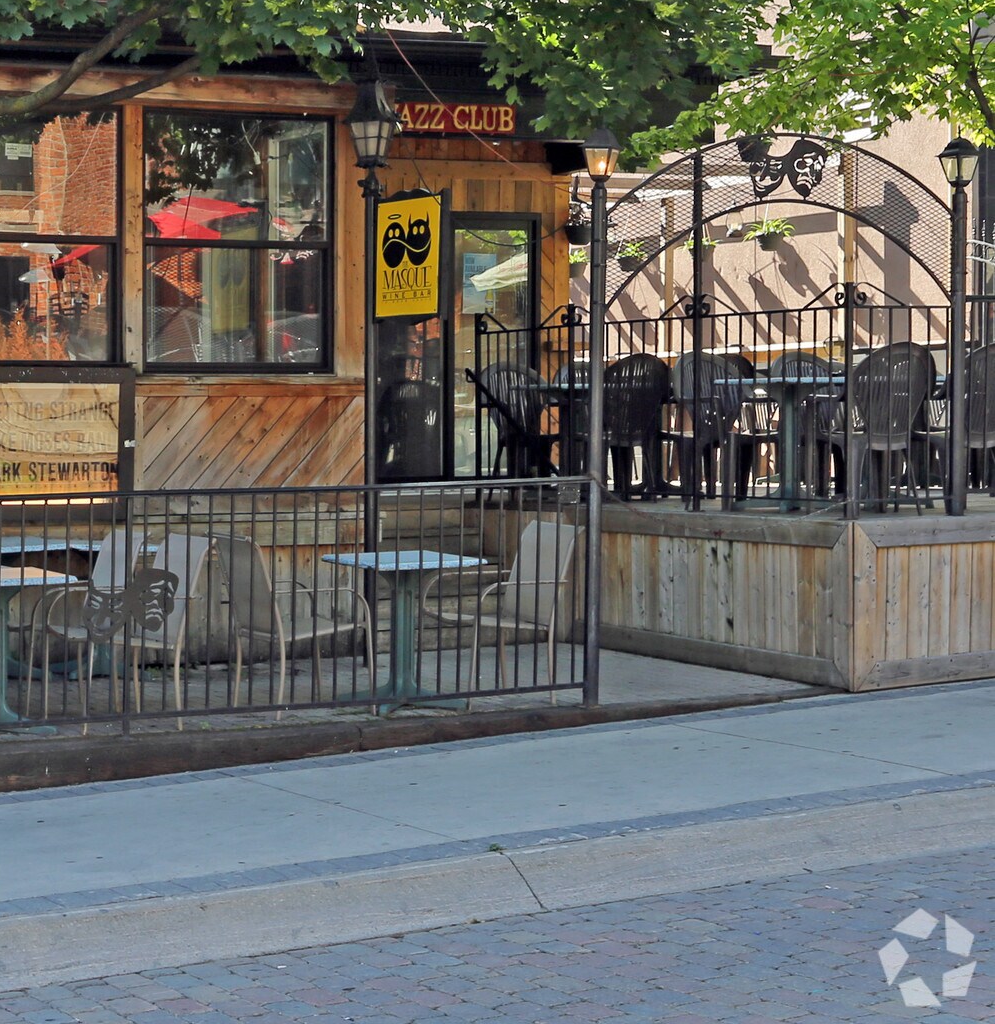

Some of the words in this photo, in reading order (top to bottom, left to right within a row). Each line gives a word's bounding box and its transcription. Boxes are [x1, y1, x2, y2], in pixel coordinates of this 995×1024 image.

[453, 105, 514, 131] CLUB
[382, 265, 432, 290] MASQUE
[382, 291, 406, 300] WINE
[413, 289, 431, 298] BAR
